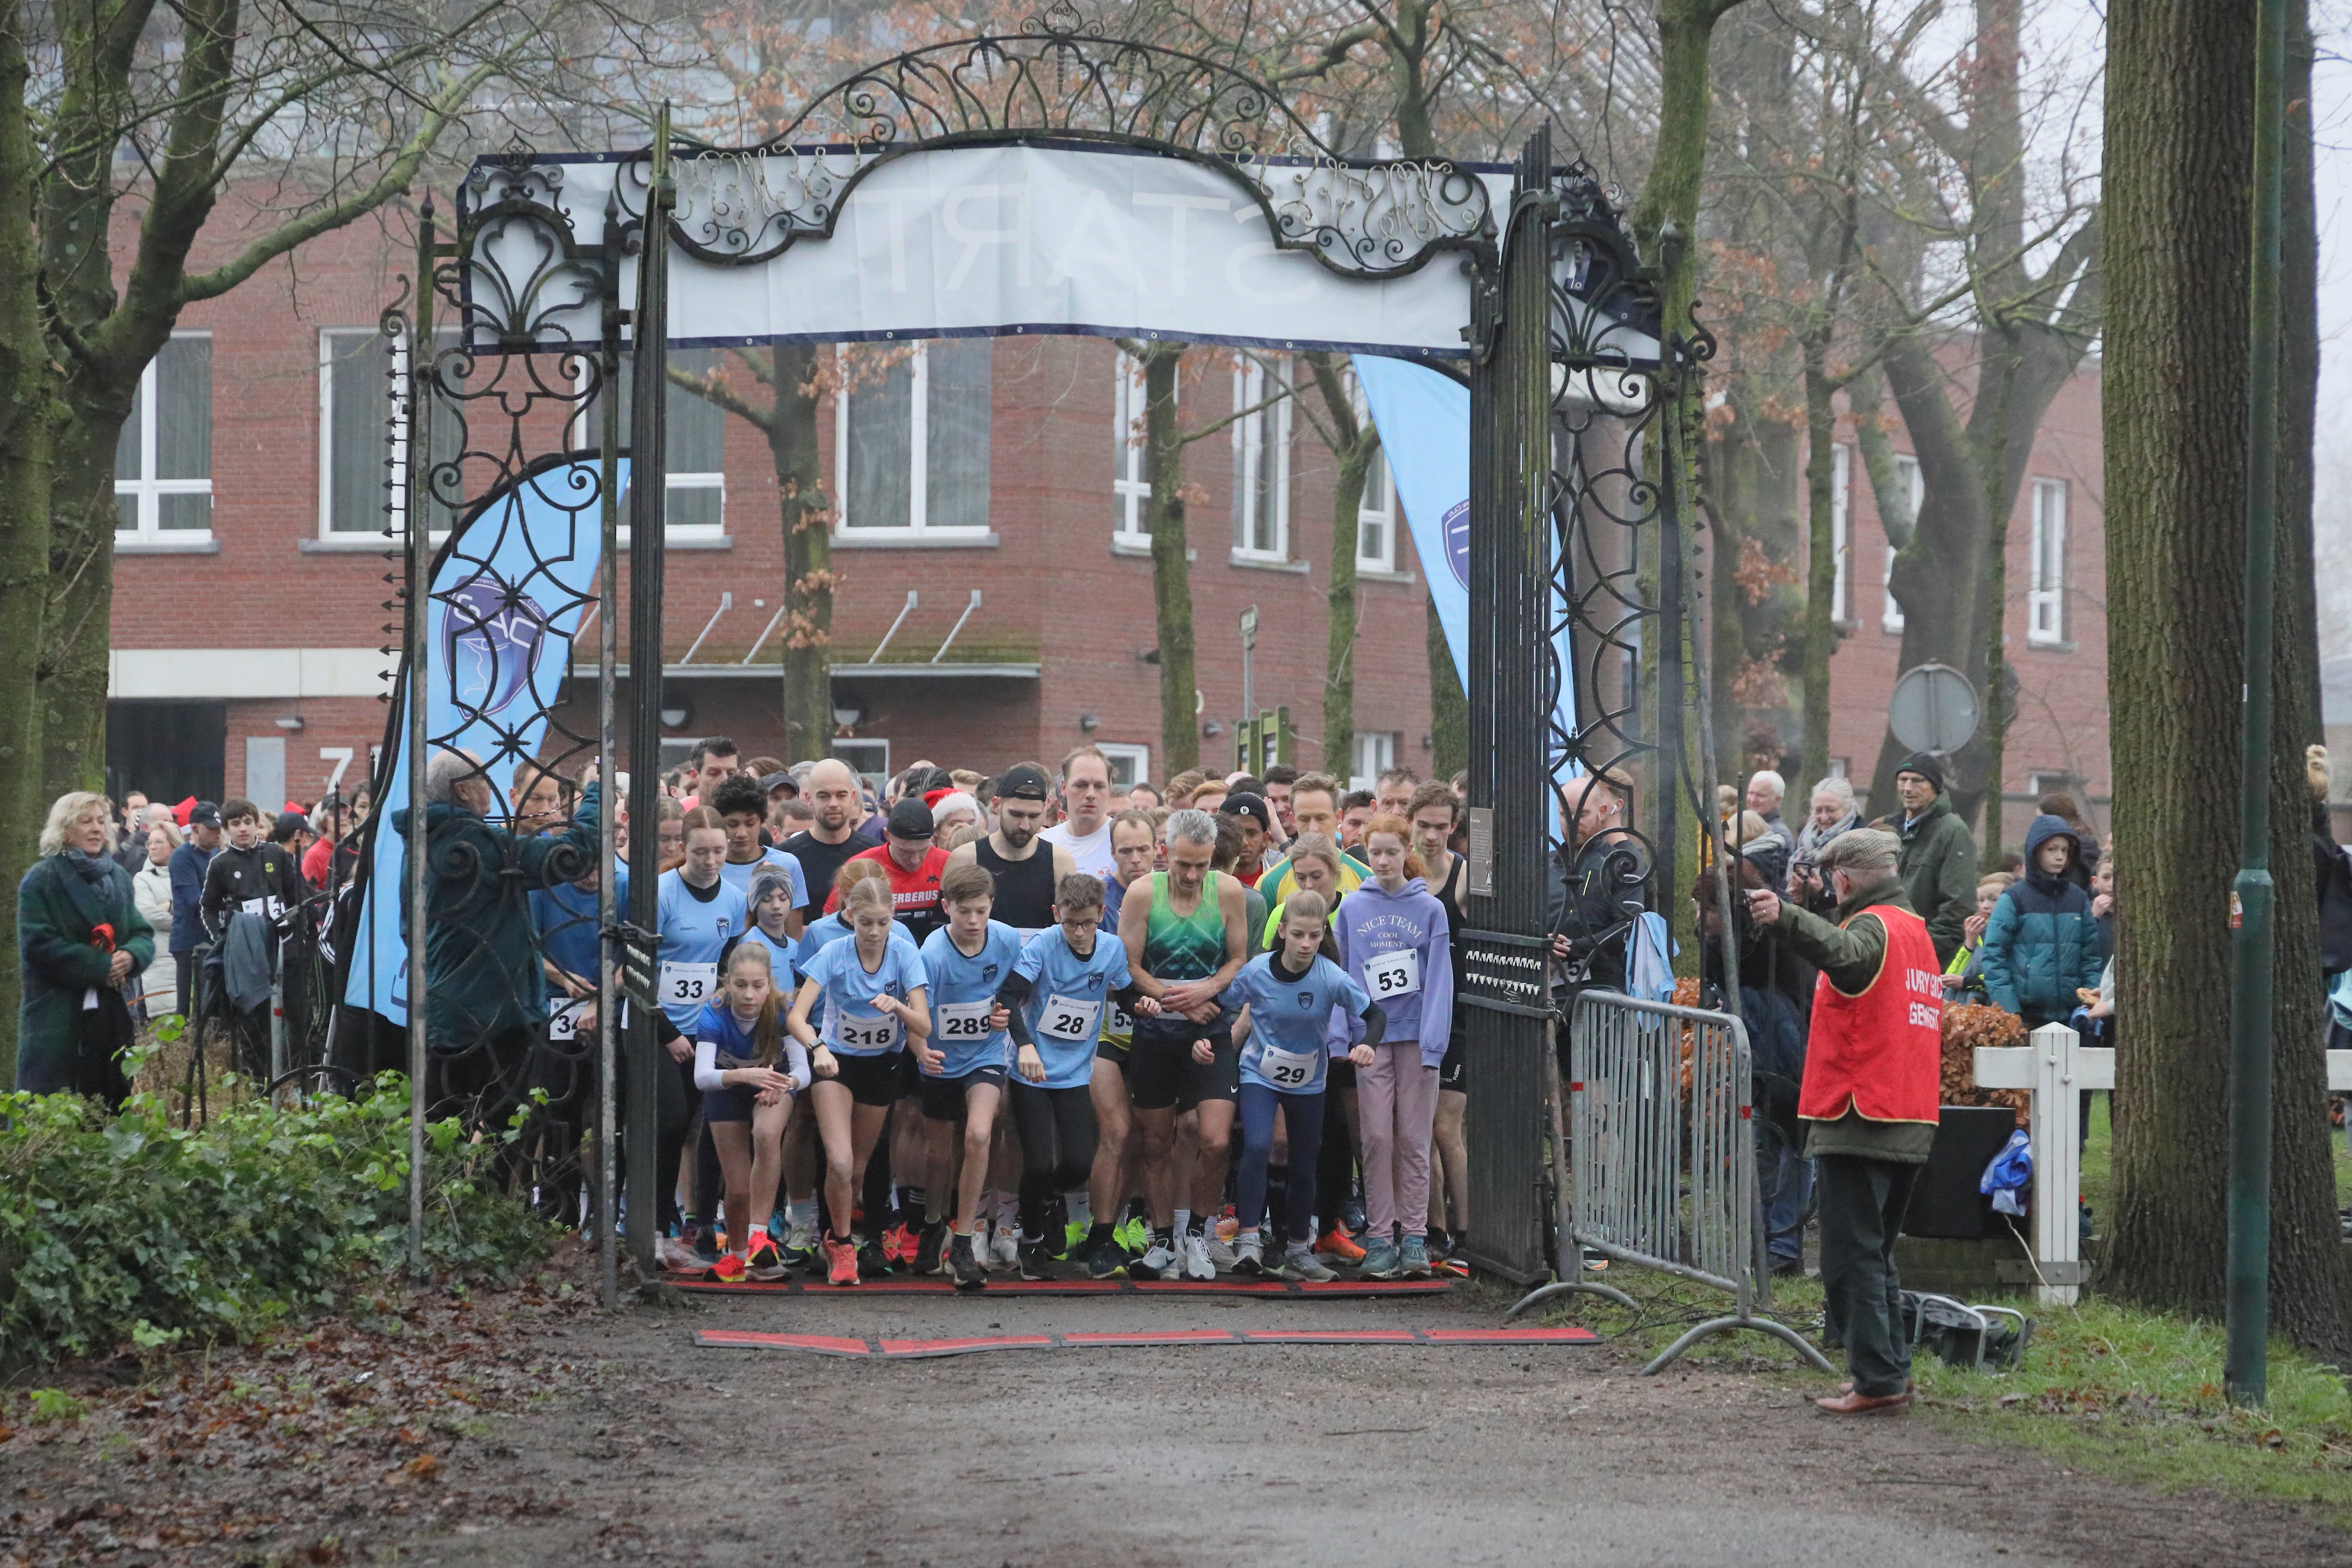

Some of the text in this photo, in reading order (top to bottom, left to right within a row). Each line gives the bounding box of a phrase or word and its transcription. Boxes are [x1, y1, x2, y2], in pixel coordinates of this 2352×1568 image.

[320, 747, 353, 795] 7
[891, 890, 938, 903] ERBERUS
[1356, 915, 1423, 939] NICE TEAM
[674, 980, 703, 998] 33
[1379, 969, 1408, 991] 53
[1905, 968, 1930, 994] JURY
[946, 1015, 991, 1034] 289
[1053, 1014, 1084, 1034] 28
[843, 1027, 890, 1045] 218
[1273, 1066, 1305, 1083] 29
[1453, 1064, 1461, 1081] FUSION
